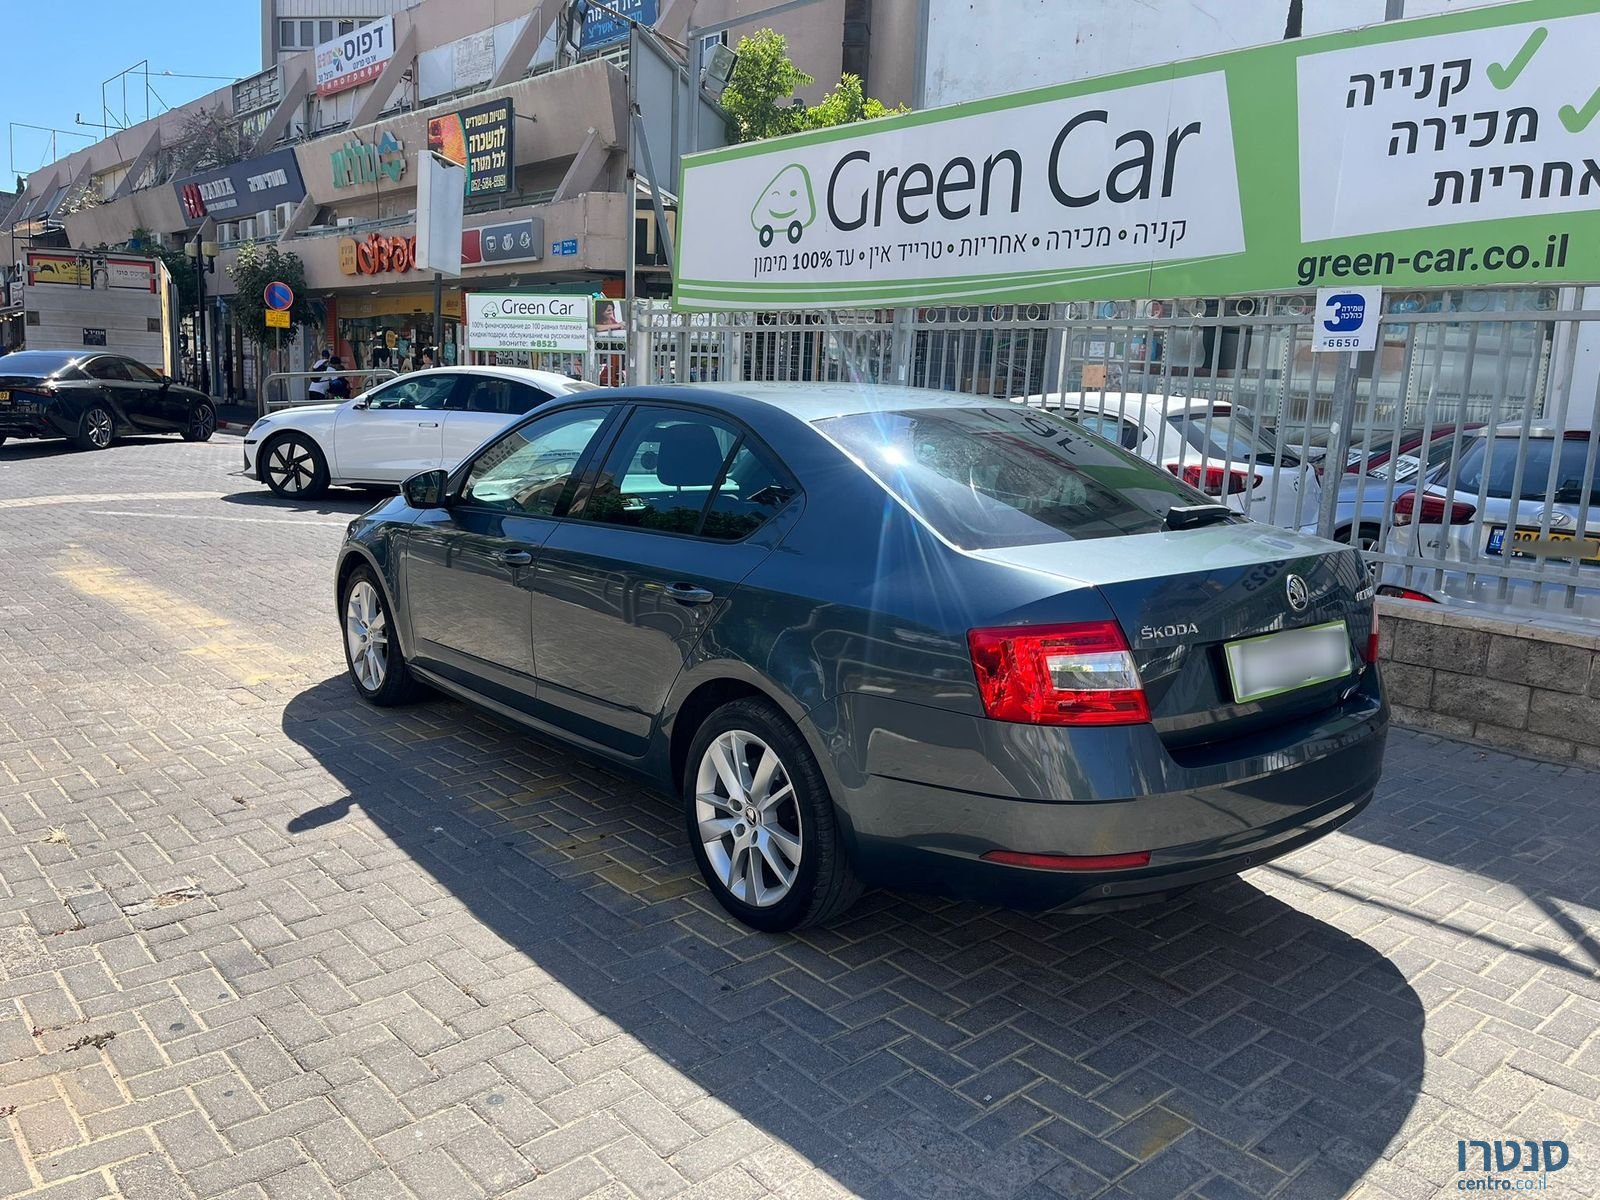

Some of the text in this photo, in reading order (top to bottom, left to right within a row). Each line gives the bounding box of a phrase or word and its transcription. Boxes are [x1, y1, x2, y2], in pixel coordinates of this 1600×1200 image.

[344, 26, 384, 61] דפוס
[1346, 58, 1472, 109] קנייה
[469, 125, 506, 154] להשכרה
[1387, 105, 1539, 157] מכירה
[471, 150, 506, 173] לכל מטרה
[826, 110, 1201, 232] Green Car
[1427, 157, 1600, 207] אחריות
[753, 218, 1187, 278] קניה מכירה אחריות טרייד אין עד 100% מימון
[1297, 233, 1570, 286] green-car.co.il
[501, 299, 574, 315] Green Car
[484, 322, 524, 330] финансирование
[532, 322, 540, 330] 100
[509, 331, 543, 339] обслуживание
[1493, 535, 1501, 544] IL
[1141, 622, 1199, 641] ŠKODA
